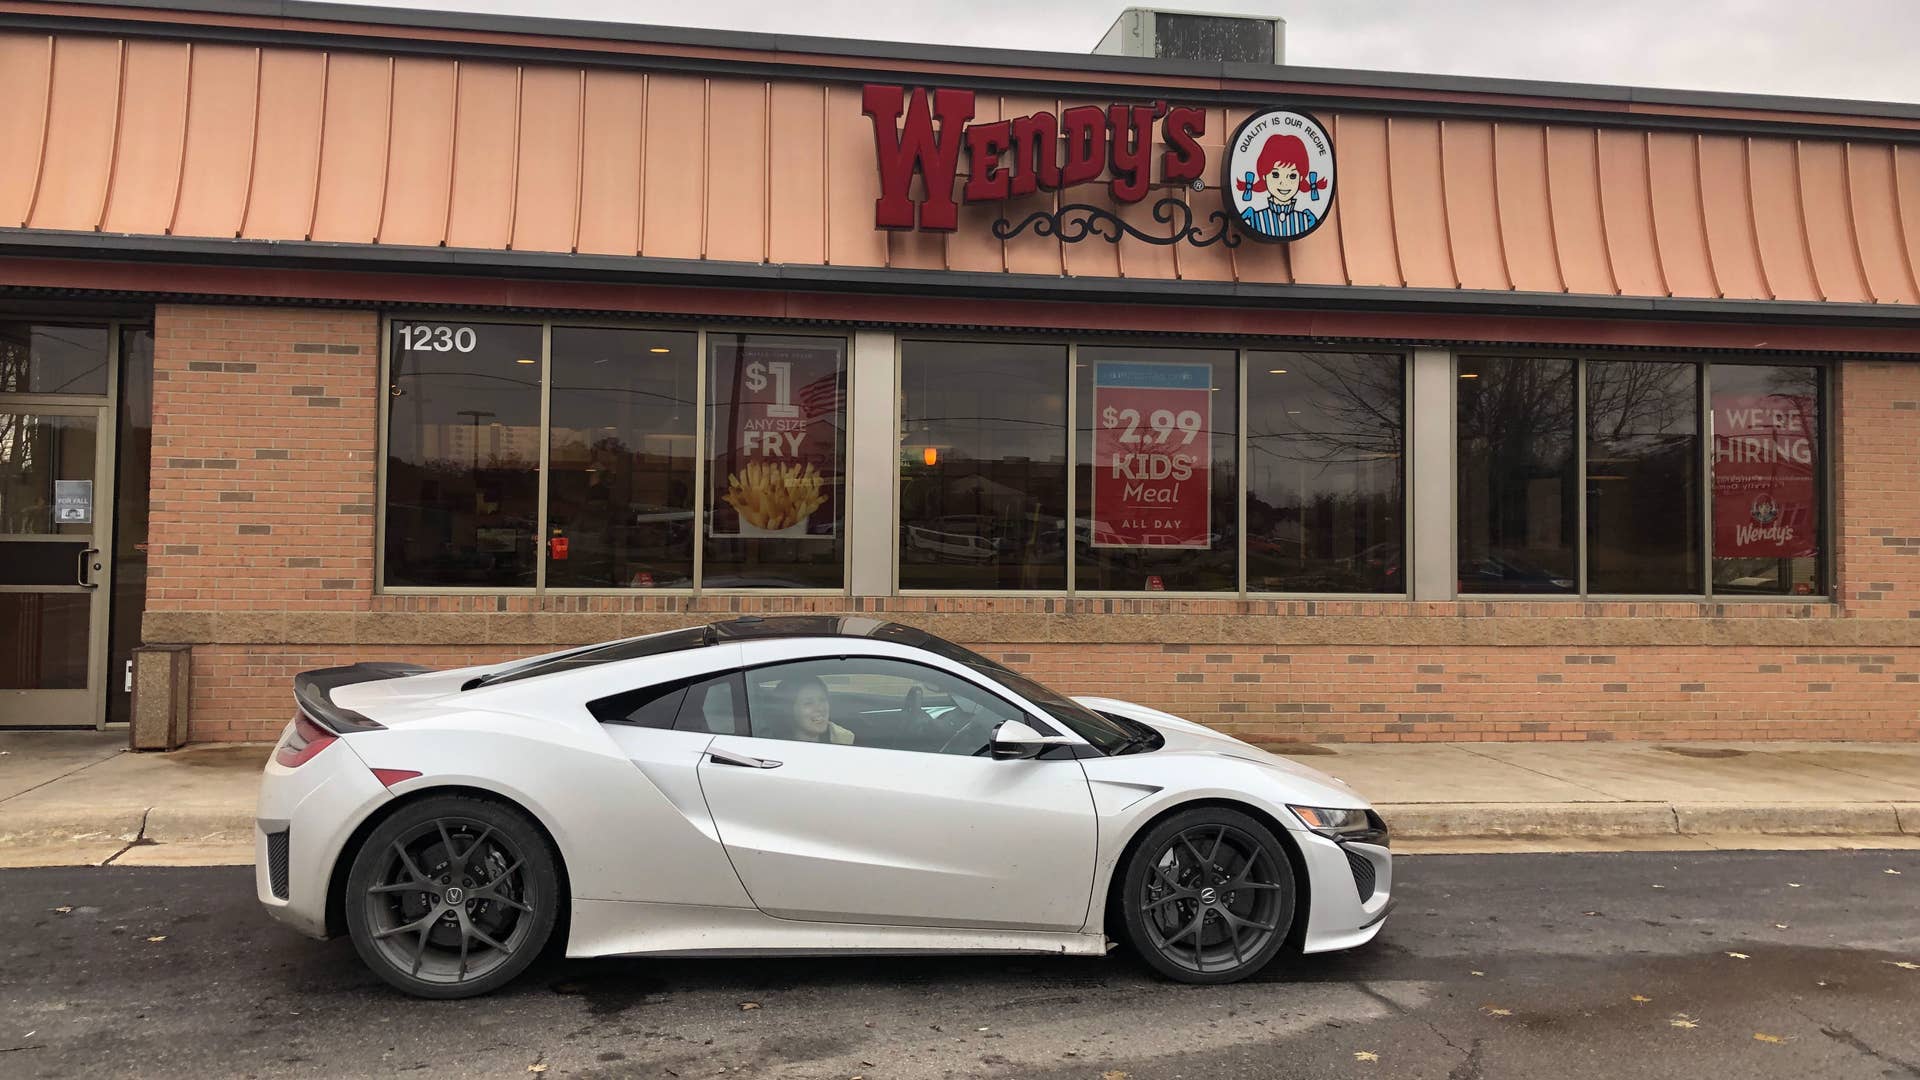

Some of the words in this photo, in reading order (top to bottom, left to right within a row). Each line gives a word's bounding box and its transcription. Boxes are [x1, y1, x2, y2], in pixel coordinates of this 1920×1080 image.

[1240, 120, 1268, 153] QUALITY
[1271, 117, 1281, 126] IS
[1284, 116, 1303, 129] OUR
[1304, 126, 1327, 157] RECIPE
[399, 325, 477, 353] 1230
[745, 361, 799, 418] $1
[744, 419, 773, 431] ANY
[776, 420, 807, 432] SIZE
[1102, 405, 1202, 445] $2.99
[1726, 408, 1803, 431] WE'RE
[743, 431, 808, 457] FRY
[1715, 437, 1812, 464] HIRING
[1112, 453, 1198, 481] KIDS'
[1123, 482, 1180, 503] Meal
[1122, 519, 1147, 529] ALL
[1154, 520, 1183, 529] DAY
[1736, 521, 1794, 547] Wendy's
